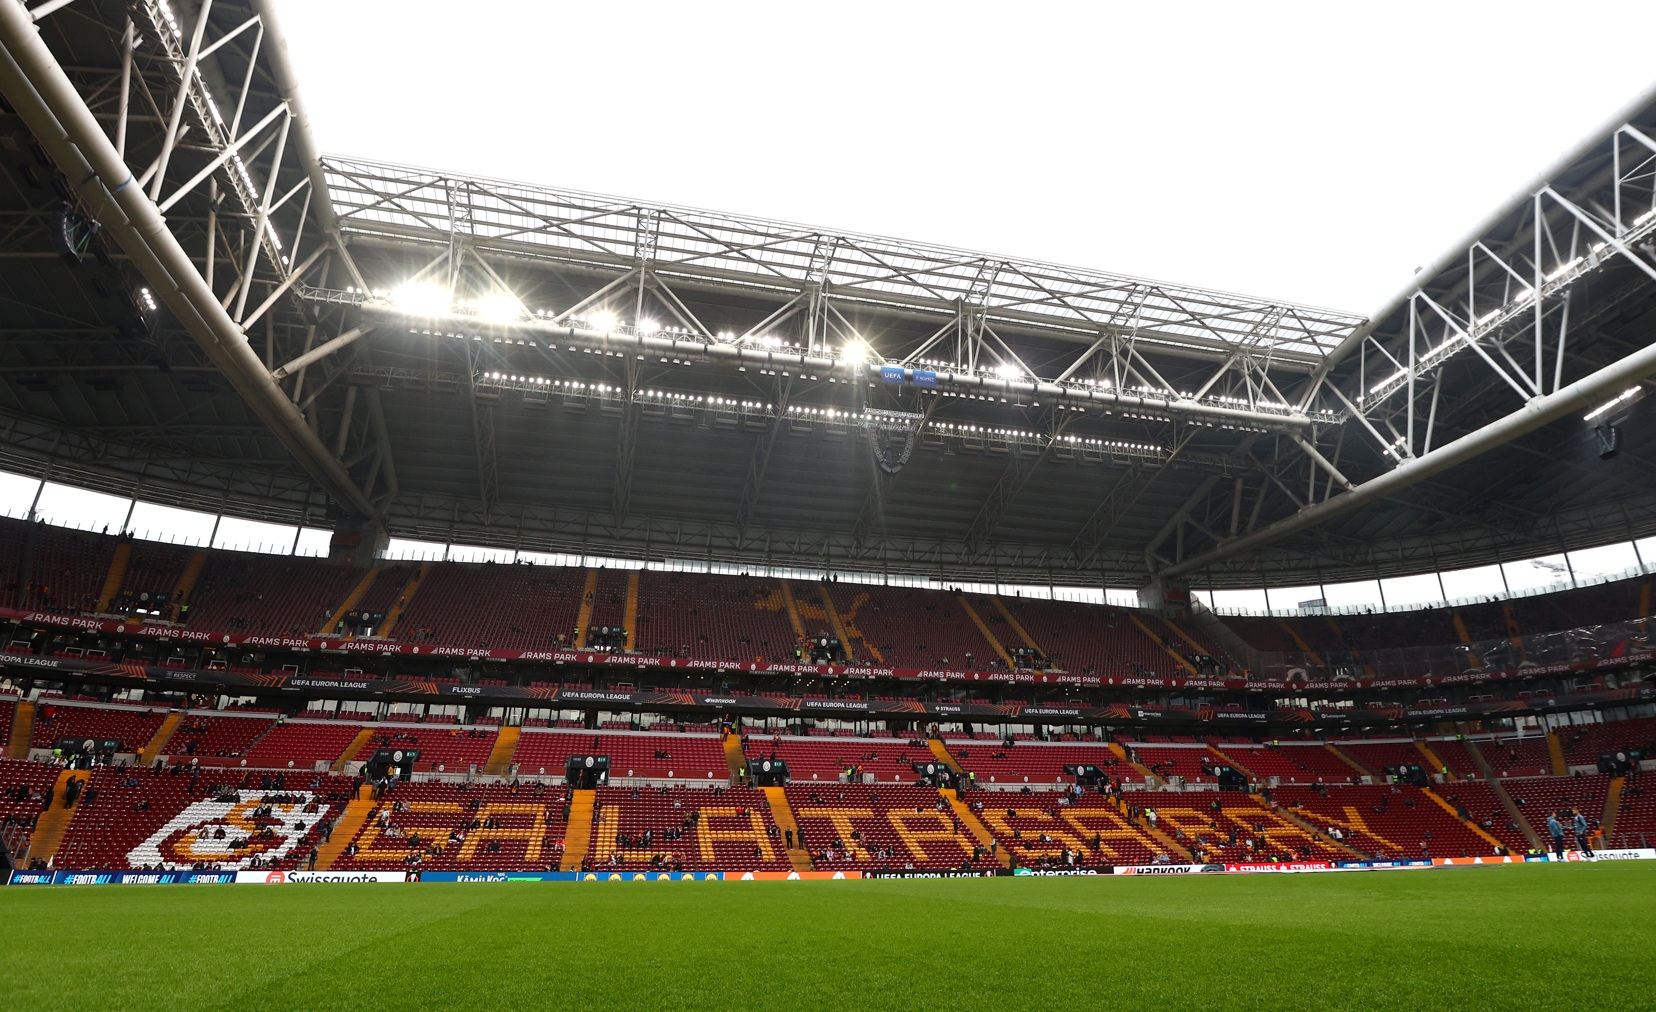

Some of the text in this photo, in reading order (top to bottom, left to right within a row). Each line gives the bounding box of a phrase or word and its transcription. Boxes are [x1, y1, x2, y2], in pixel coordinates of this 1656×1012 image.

[35, 614, 104, 629] RAMS PARK
[147, 627, 211, 640] RAMS PARK
[251, 637, 280, 646] RAMS
[438, 647, 491, 657] RAMS PARK
[24, 657, 59, 667] LEAGUE
[1603, 653, 1652, 666] RAMS PARK
[1523, 665, 1570, 676] RAMS PARK
[1580, 851, 1640, 860] Sissuote
[13, 875, 52, 883] #FOOTBALL
[64, 875, 112, 884] #FOOTBALL
[122, 875, 176, 883] WELCOME ALL
[188, 875, 233, 883] #FOOTBALL
